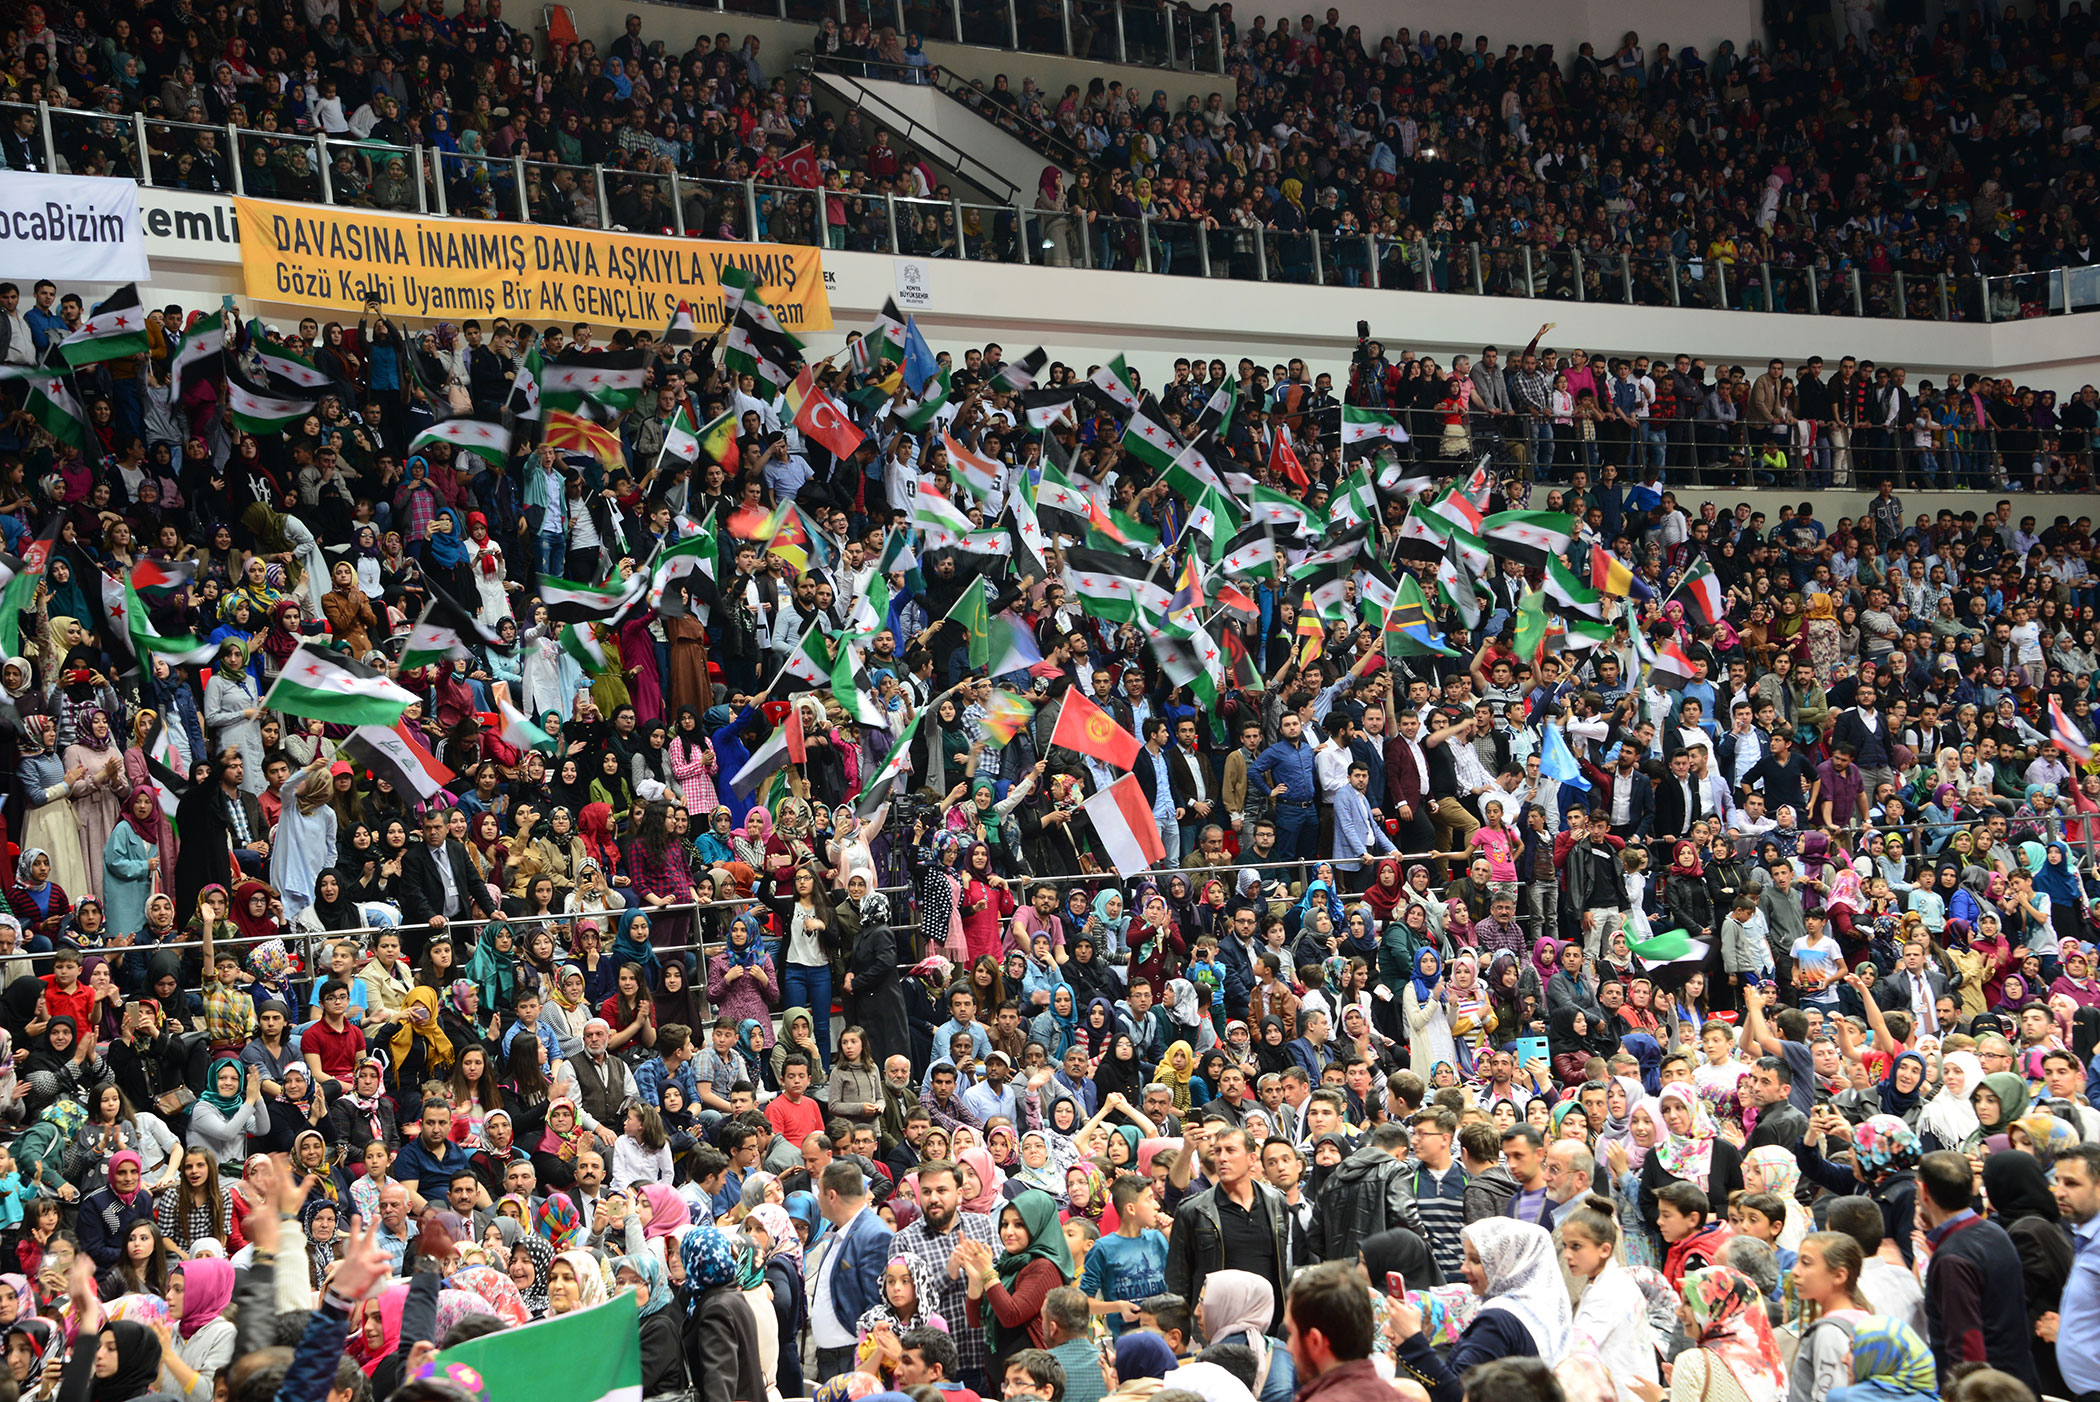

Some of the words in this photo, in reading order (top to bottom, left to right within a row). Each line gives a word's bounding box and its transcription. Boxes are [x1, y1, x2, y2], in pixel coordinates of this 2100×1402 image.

[139, 205, 241, 244] emli
[273, 214, 411, 267] DAVASINA
[417, 223, 526, 276] İNANMIŞ
[534, 235, 600, 277] DAVA
[608, 244, 705, 287] AŞKIYLA
[276, 261, 332, 300] Gözü
[338, 269, 396, 306] Kalbi
[403, 275, 495, 316] Uyanmış
[502, 280, 532, 311] Bir
[540, 280, 568, 313] AK
[573, 284, 660, 323] GENÇLİK
